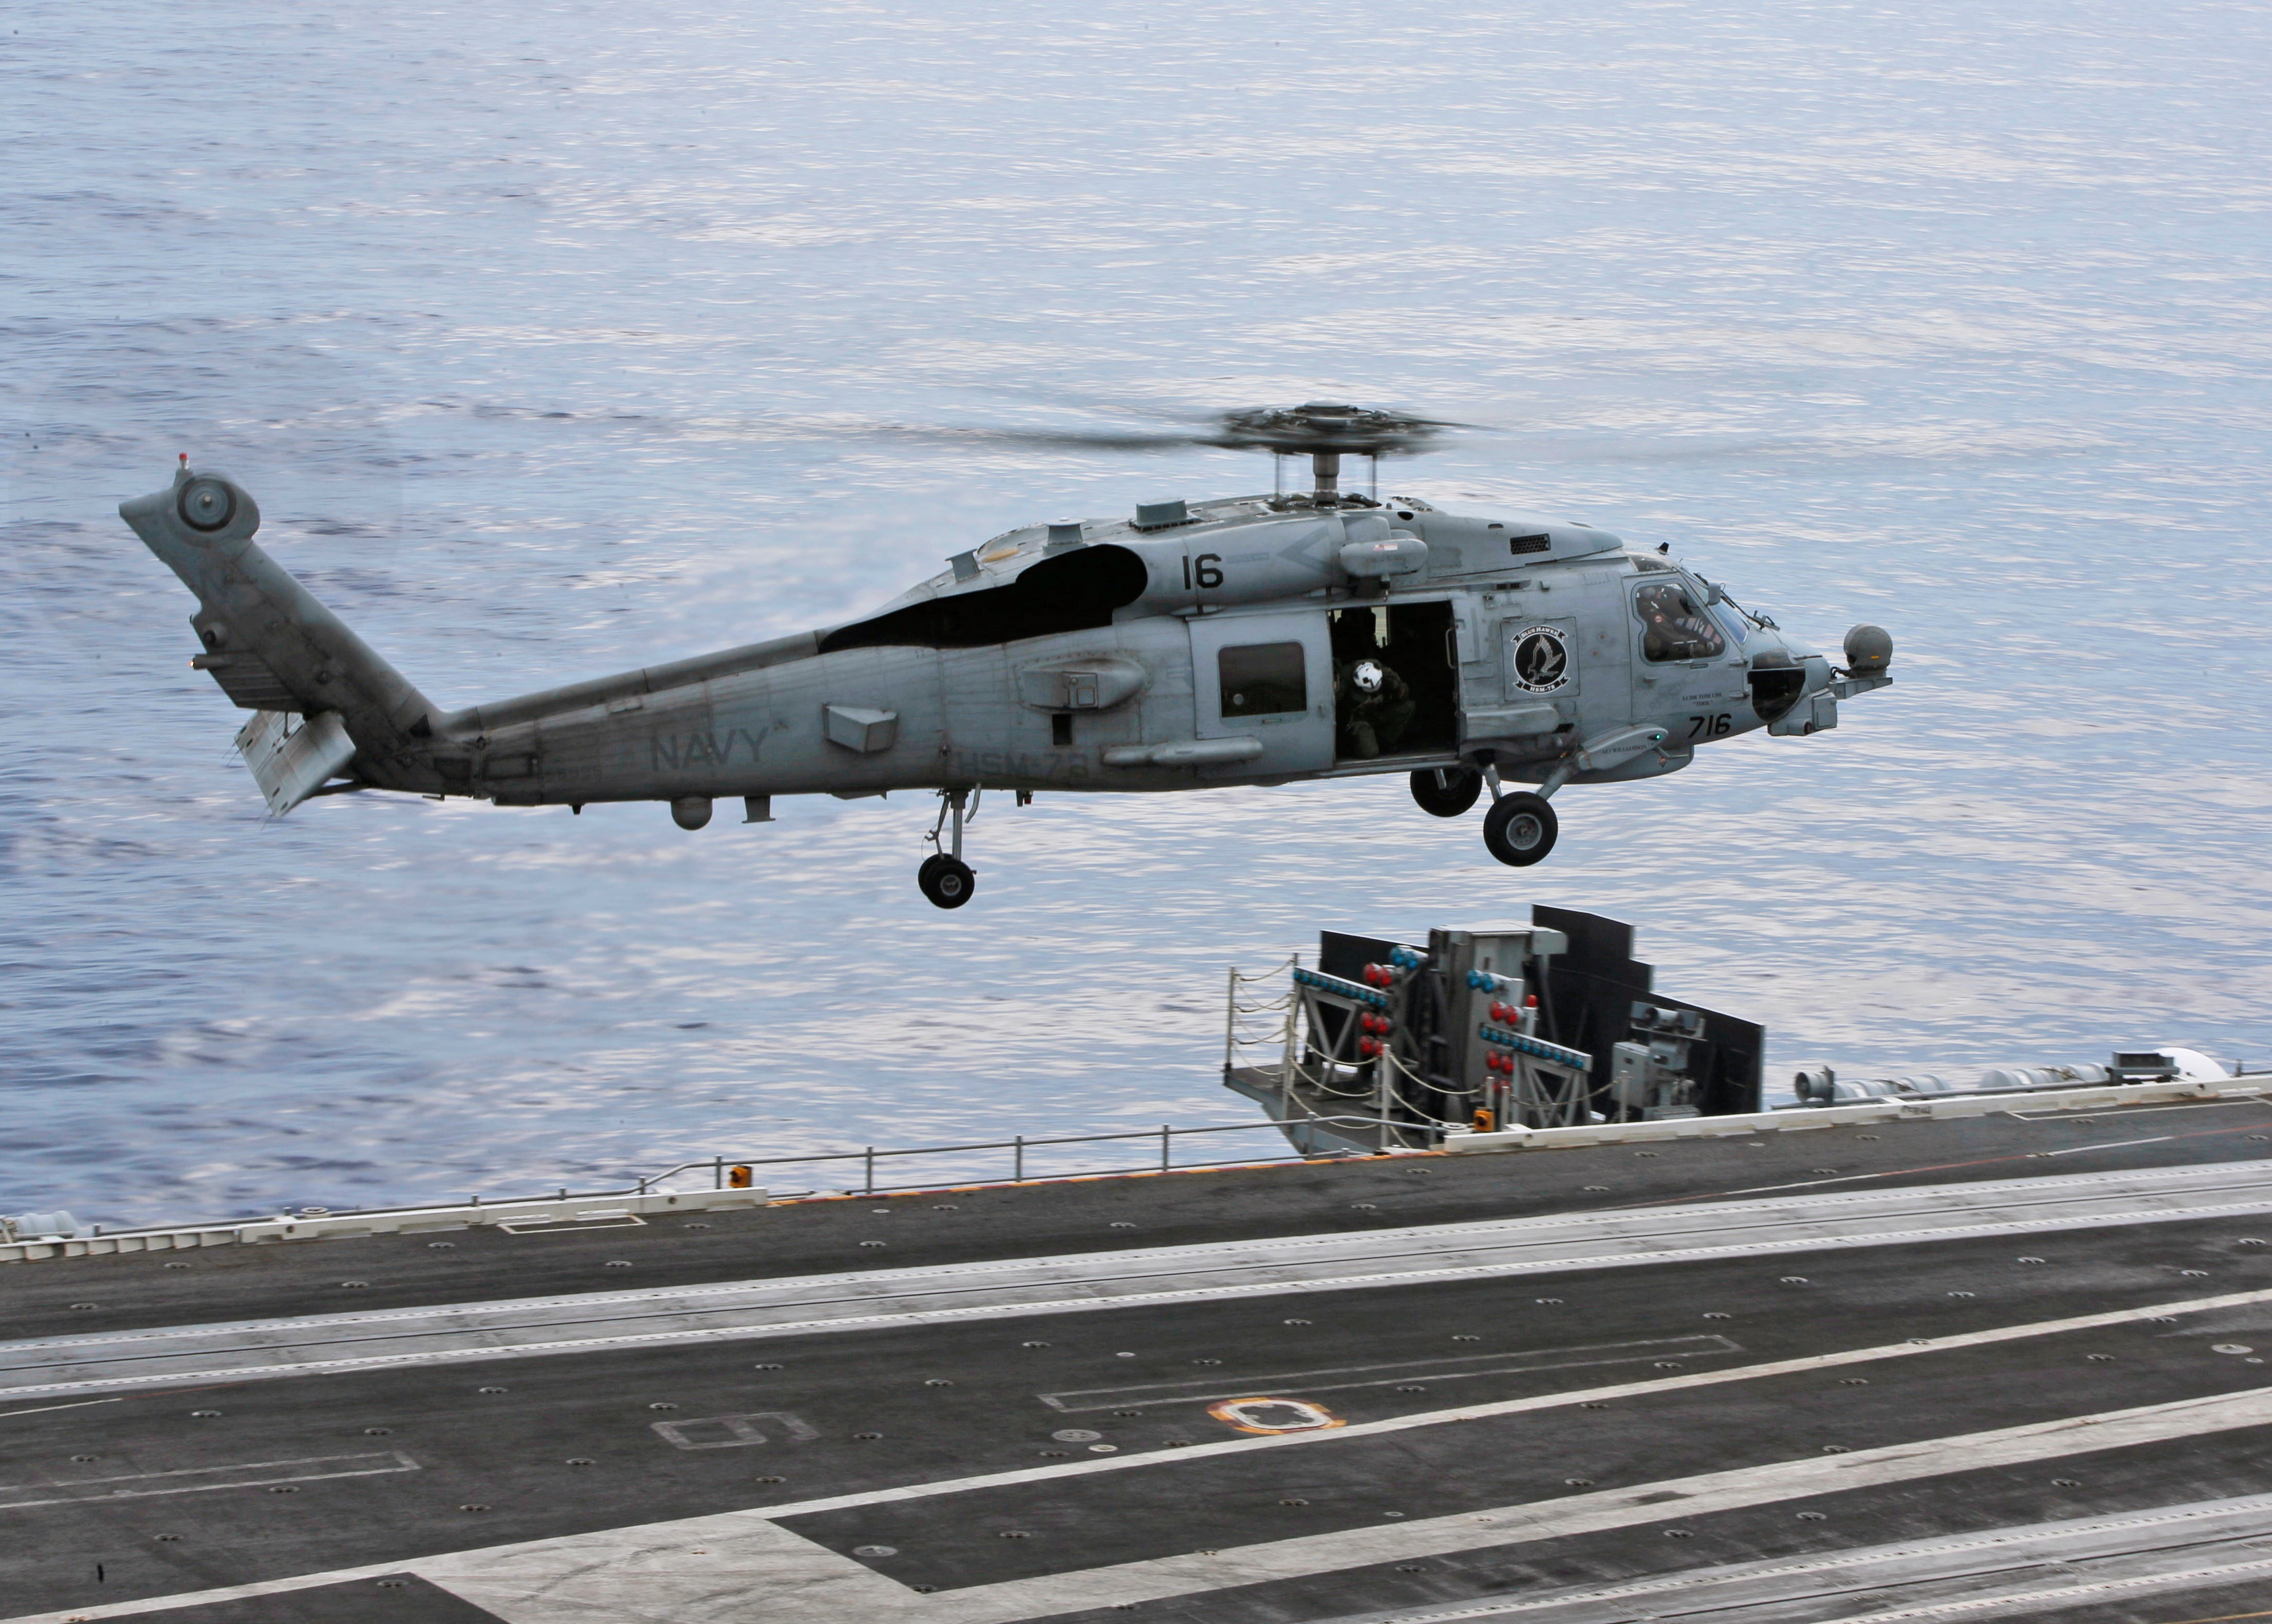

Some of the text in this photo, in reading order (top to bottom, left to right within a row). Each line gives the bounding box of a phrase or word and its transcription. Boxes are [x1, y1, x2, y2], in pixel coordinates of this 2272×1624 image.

[1182, 553, 1223, 590] 16
[1520, 627, 1558, 638] BLUE HAWKS
[1530, 684, 1555, 693] HSM-78
[1687, 713, 1732, 738] 716
[650, 726, 769, 771] NAVY
